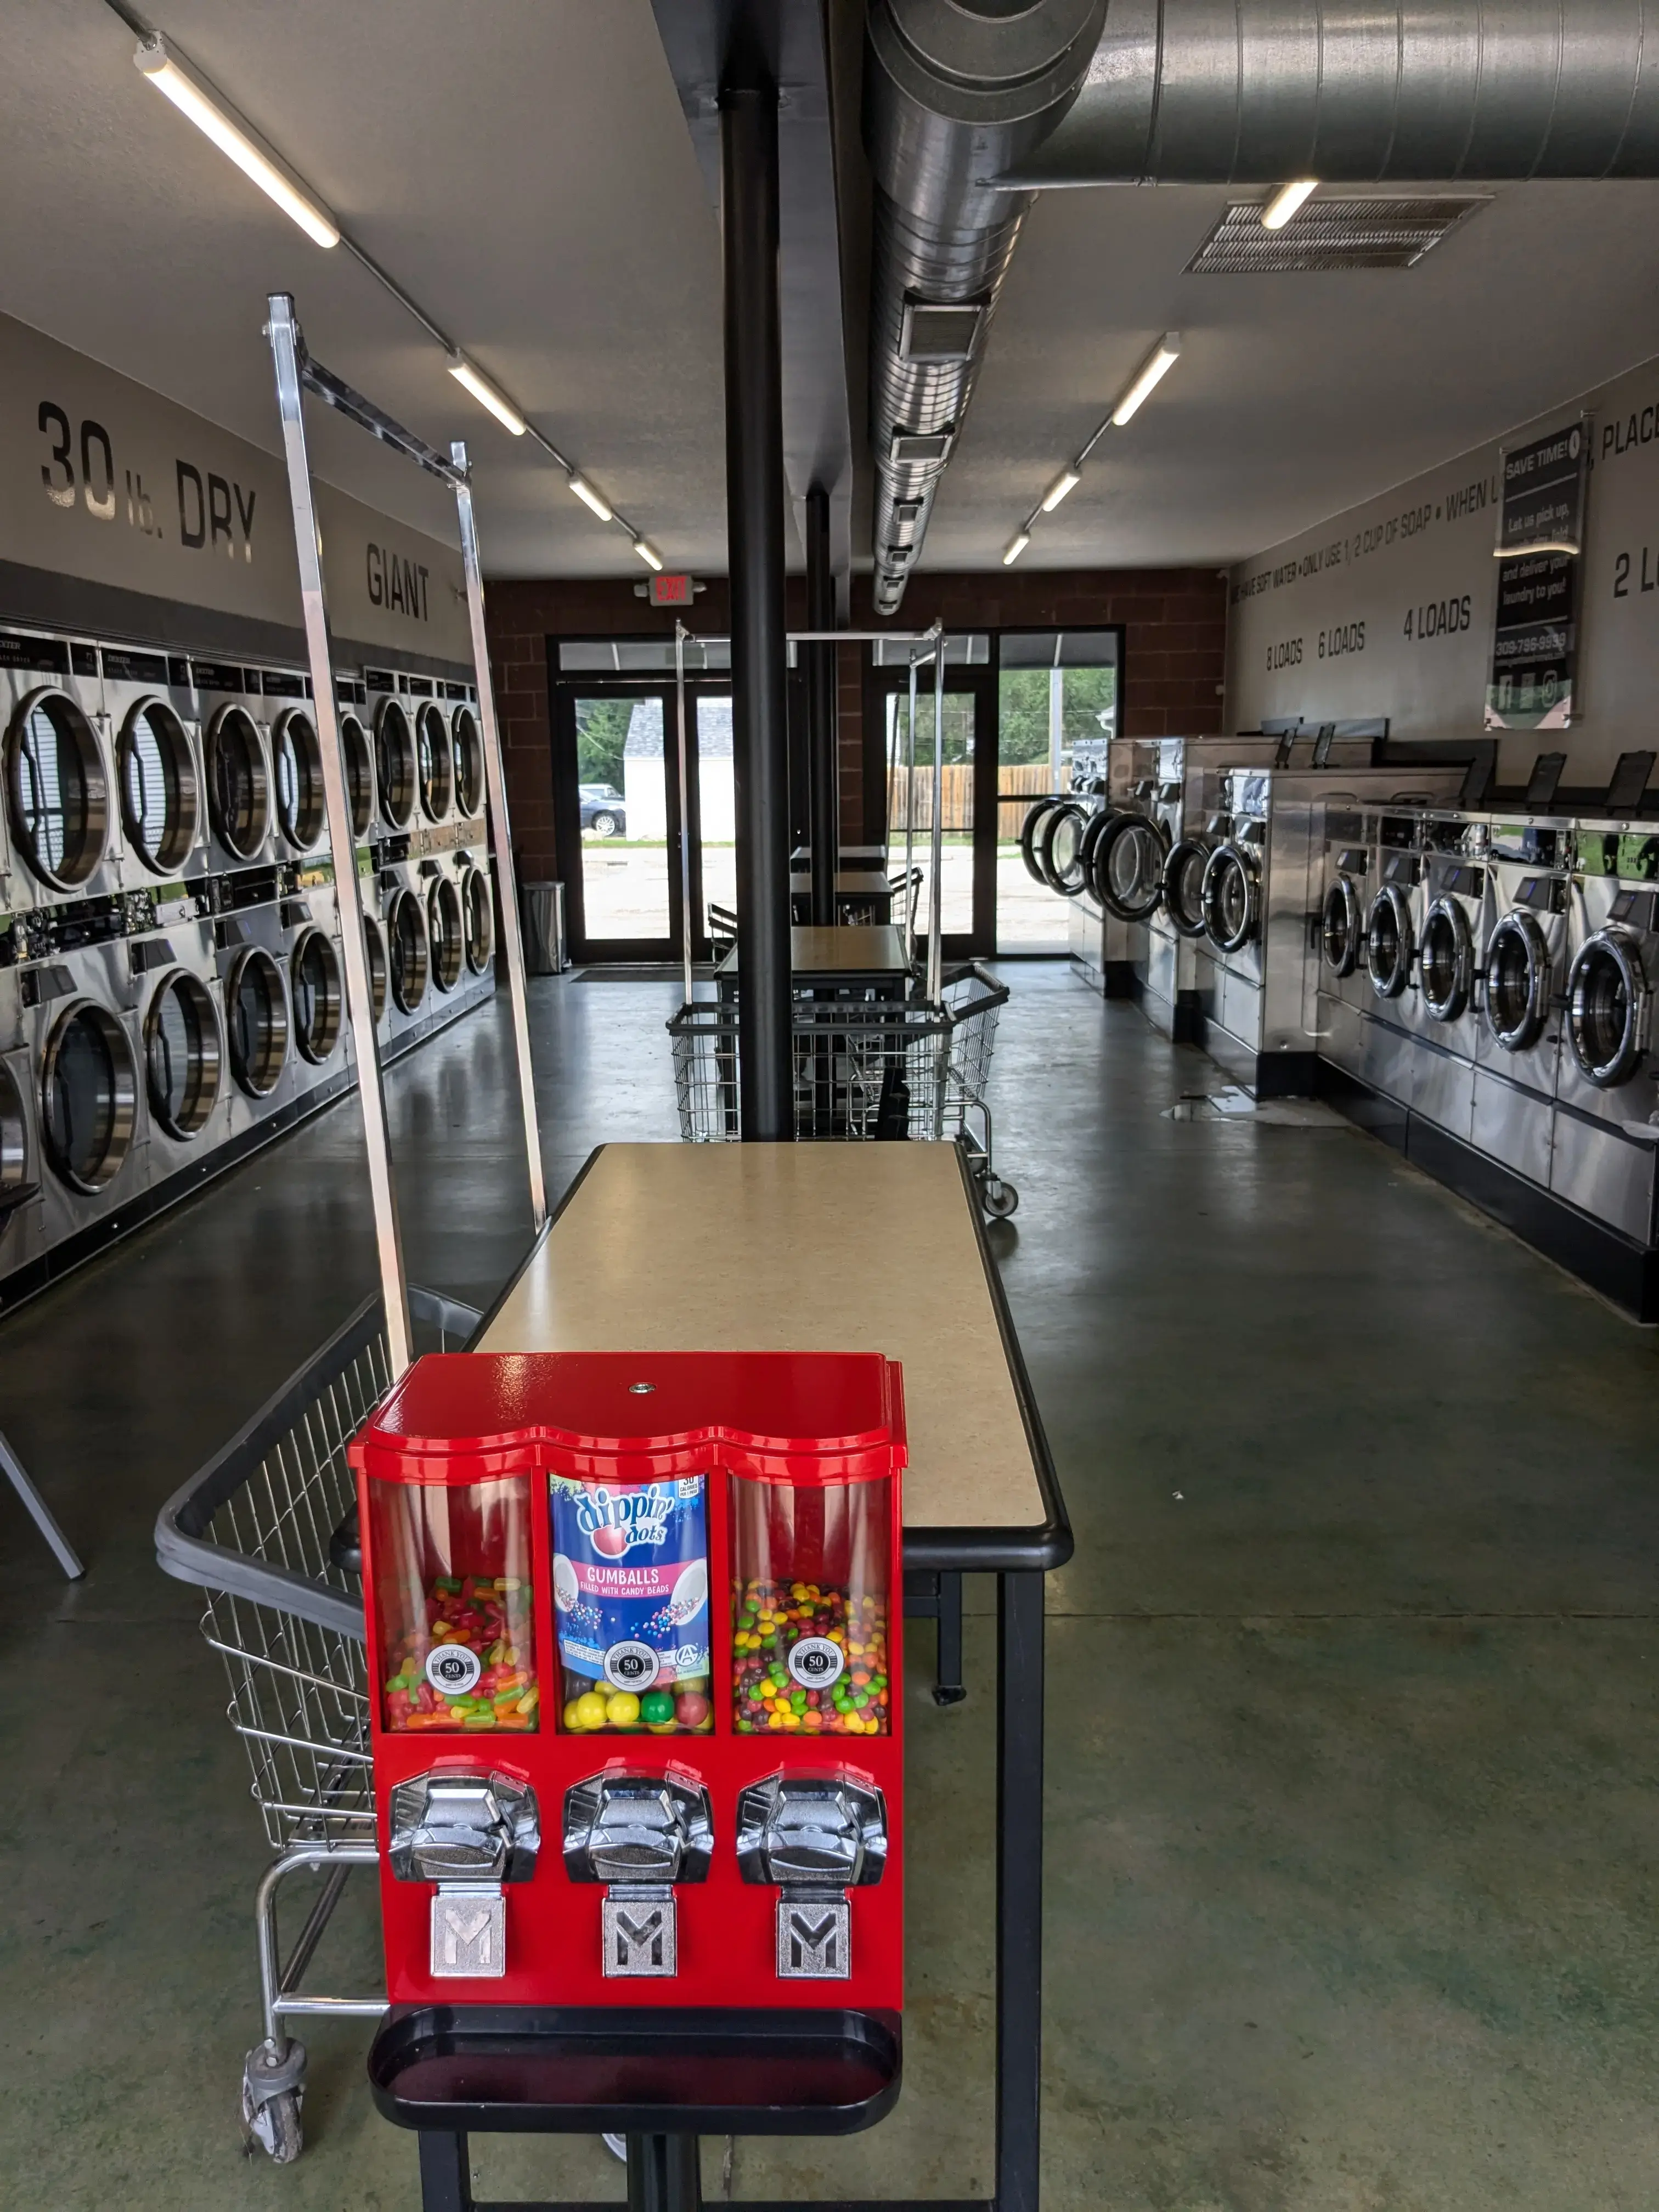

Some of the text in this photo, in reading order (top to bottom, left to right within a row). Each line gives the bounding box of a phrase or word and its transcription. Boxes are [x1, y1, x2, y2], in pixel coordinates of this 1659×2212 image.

[1506, 454, 1534, 480] SAVE
[1537, 439, 1568, 467] TIME!
[38, 401, 256, 564] 30 lb. DRY
[1525, 514, 1534, 529] us
[1537, 504, 1554, 528] pick
[1556, 502, 1570, 521] up,
[1256, 571, 1272, 594] SOFT
[1273, 562, 1296, 589] WATER
[1302, 550, 1324, 577] ONLY
[1324, 541, 1342, 568] USE
[1363, 525, 1383, 554] CUP
[1386, 517, 1398, 545] OF
[1401, 504, 1432, 539] SOAP
[1446, 478, 1487, 522] WHEN
[366, 543, 429, 622] GIANT
[1503, 554, 1570, 582] and deliver your
[1614, 552, 1630, 599] 2
[656, 575, 688, 601] EXIT
[1503, 576, 1567, 606] laundry to you!
[1403, 595, 1471, 641] 4 LOADS
[1266, 638, 1304, 671] 8 LOADS
[1318, 621, 1366, 659] 6 LOADS
[680, 1483, 697, 1492] CALORIES
[577, 1485, 674, 1532] dippin'
[625, 1525, 664, 1544] dots
[580, 1582, 669, 1595] FILLED WITH CANDY BEADS
[587, 1567, 659, 1585] GUMBALLS
[435, 1650, 470, 1663] THANK YOU
[613, 1647, 634, 1660] THANK
[636, 1648, 648, 1657] YOU
[798, 1644, 834, 1655] THANK YOU
[809, 1655, 823, 1667] 50
[445, 1662, 460, 1674] 50
[624, 1658, 638, 1671] 50
[444, 1909, 492, 1965] M
[616, 1910, 663, 1966] M
[790, 1911, 837, 1968] M
